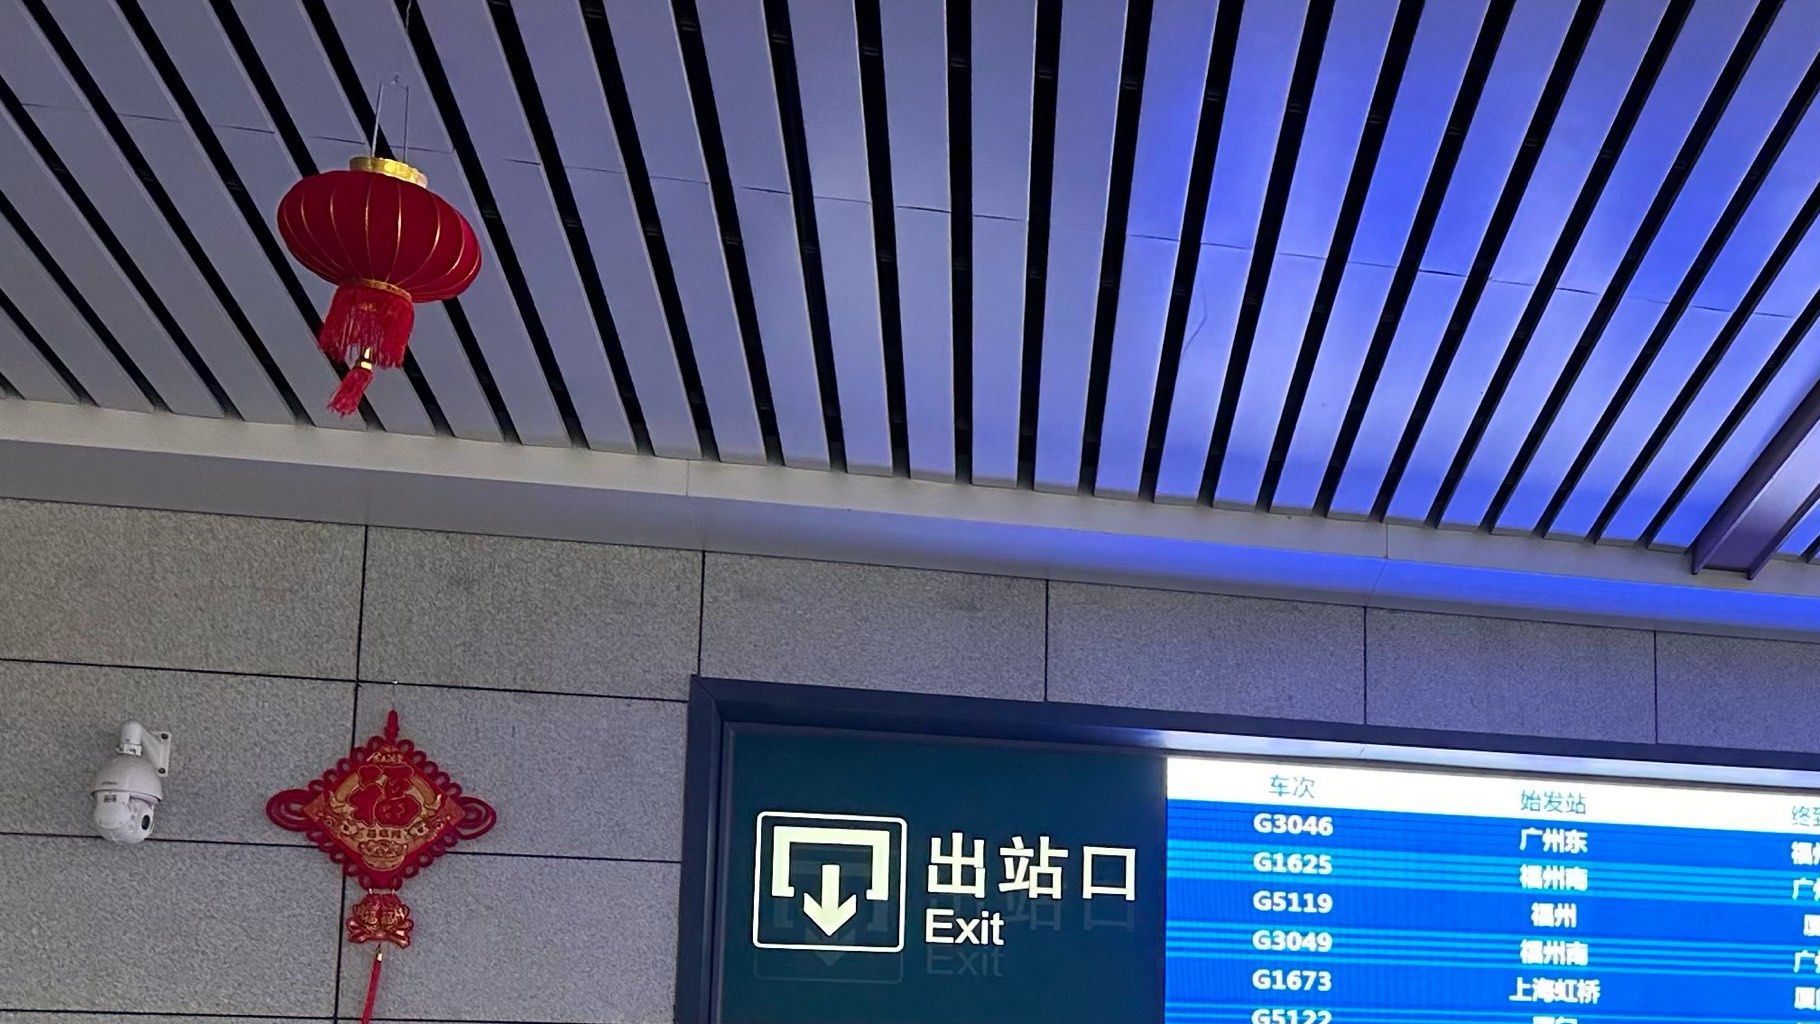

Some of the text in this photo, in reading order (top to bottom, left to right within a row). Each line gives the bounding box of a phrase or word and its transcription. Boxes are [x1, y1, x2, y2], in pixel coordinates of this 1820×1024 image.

[1268, 774, 1316, 799] 车次
[1520, 788, 1587, 815] 始发站
[1253, 813, 1334, 836] G3046
[1520, 827, 1589, 855] 广州东
[926, 832, 1136, 901] 出站口
[1253, 852, 1333, 875] G1625
[1520, 864, 1588, 892] 福州南
[925, 909, 1004, 946] Exit
[1253, 891, 1333, 914] G5119
[1531, 902, 1577, 929] 福州
[1252, 930, 1333, 953] G3049
[1520, 940, 1589, 967] 福州南
[1252, 970, 1332, 992] G1673
[1508, 977, 1600, 1004] 上海虹桥
